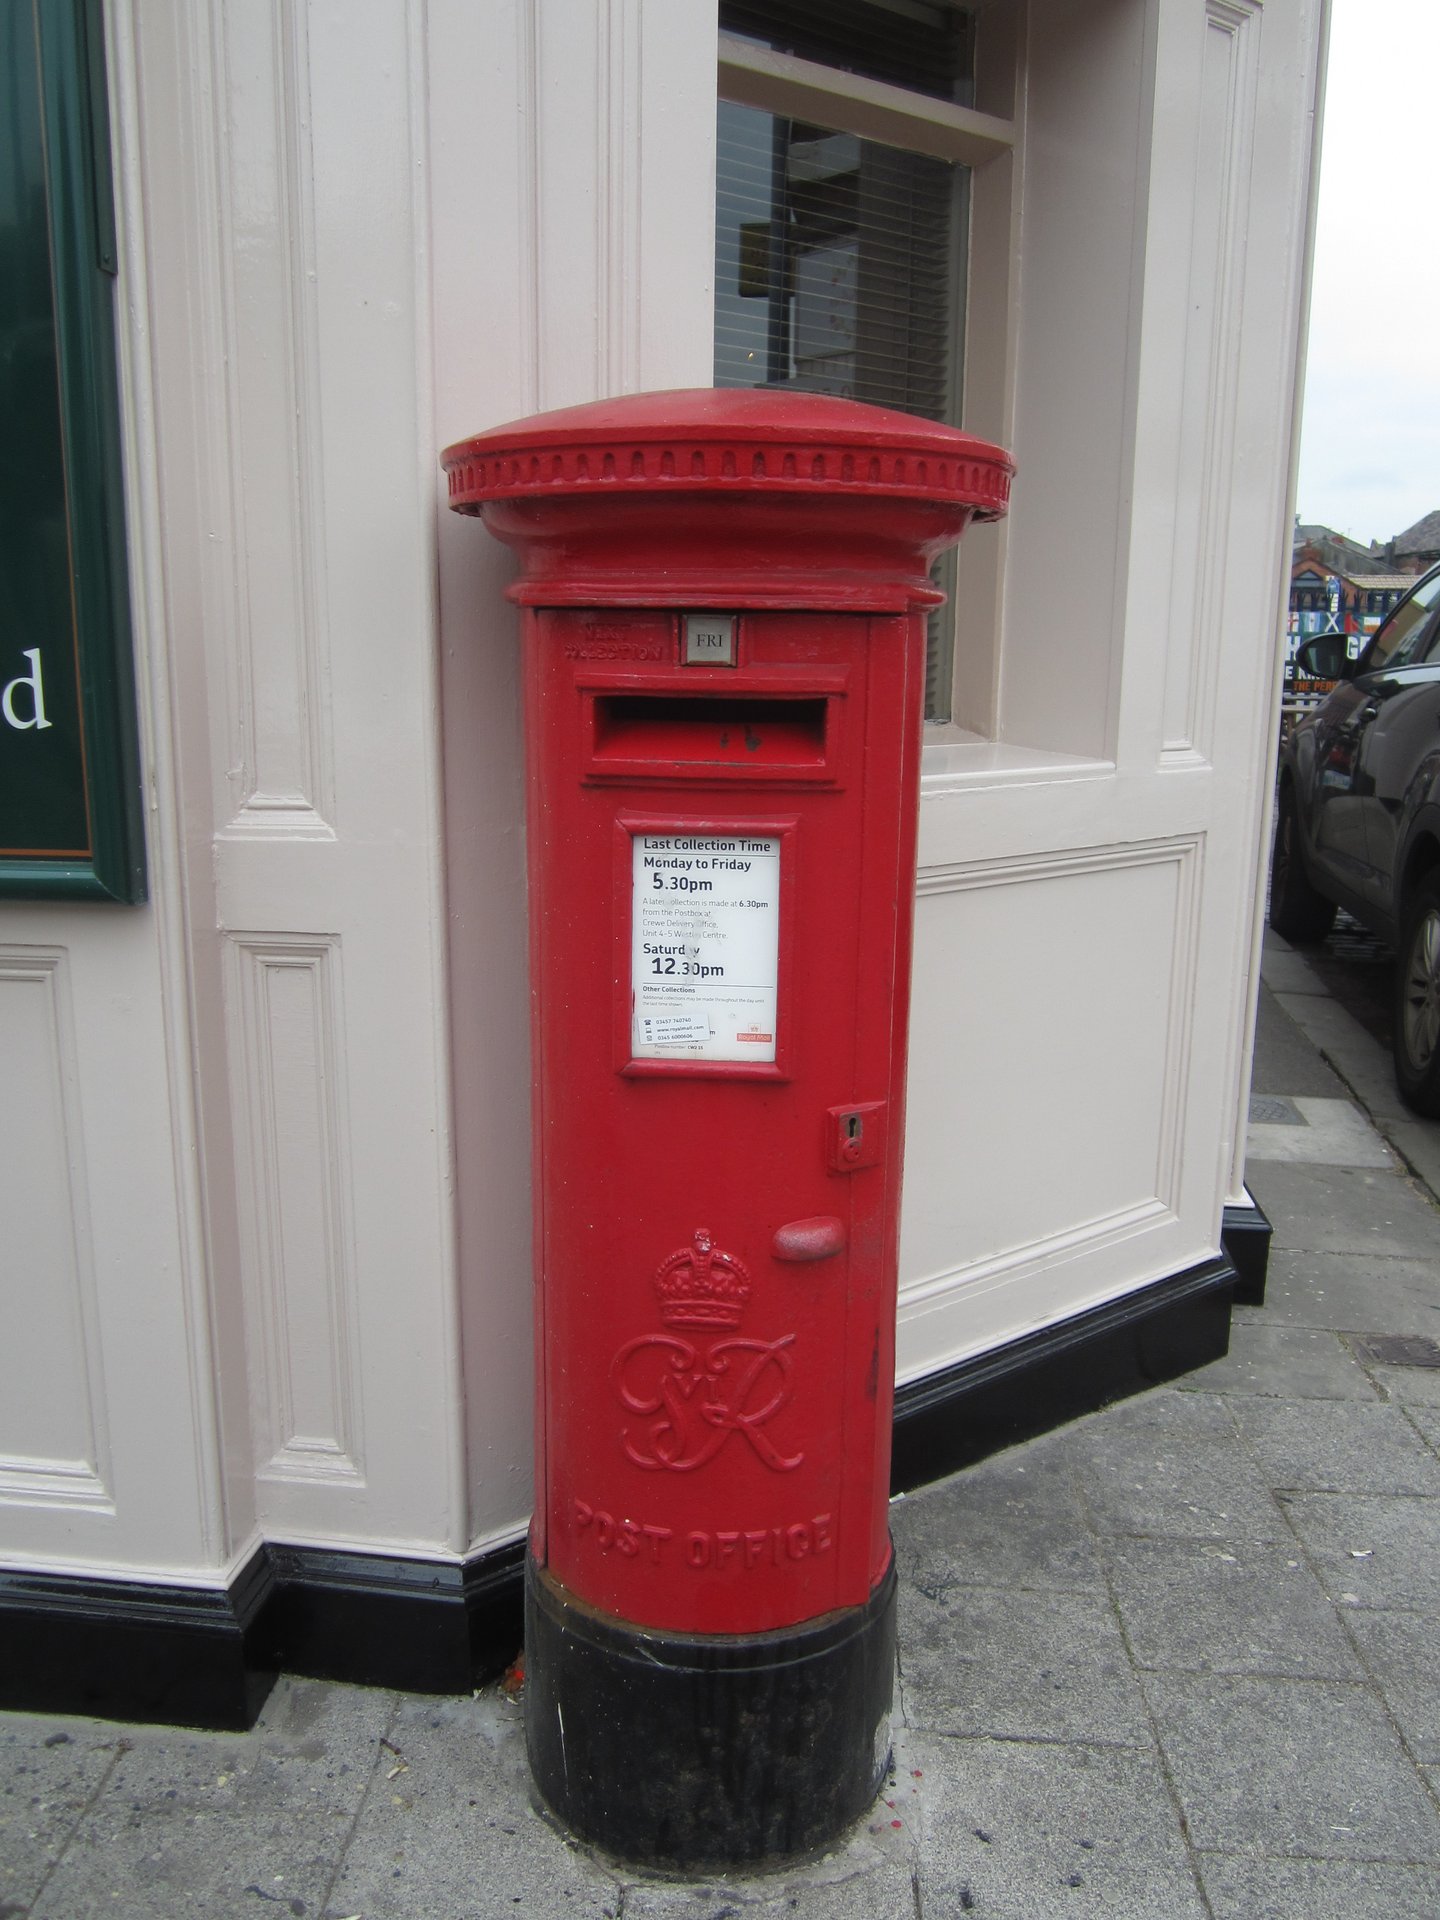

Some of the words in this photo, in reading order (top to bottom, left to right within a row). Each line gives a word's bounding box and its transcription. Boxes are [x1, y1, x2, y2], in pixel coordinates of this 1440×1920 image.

[696, 634, 723, 648] FRI
[1294, 681, 1311, 691] THE
[643, 838, 671, 849] Last
[674, 838, 736, 851] Collection
[738, 840, 771, 852] Time
[643, 857, 693, 871] Monday
[696, 859, 709, 869] to
[711, 858, 752, 872] Friday
[652, 872, 713, 893] 5.30pm
[666, 898, 700, 906] ollection
[739, 901, 769, 909] 6.30pm
[642, 908, 661, 916] from
[674, 909, 703, 917] Postbox
[642, 919, 666, 927] Crewe
[666, 920, 695, 929] Delivery
[659, 930, 673, 938] 4-5
[643, 943, 700, 958] Saturdy
[651, 958, 724, 978] 12.30pm
[661, 986, 696, 994] Collections
[573, 1499, 673, 1567] POST
[686, 1512, 832, 1569] OFFICE
